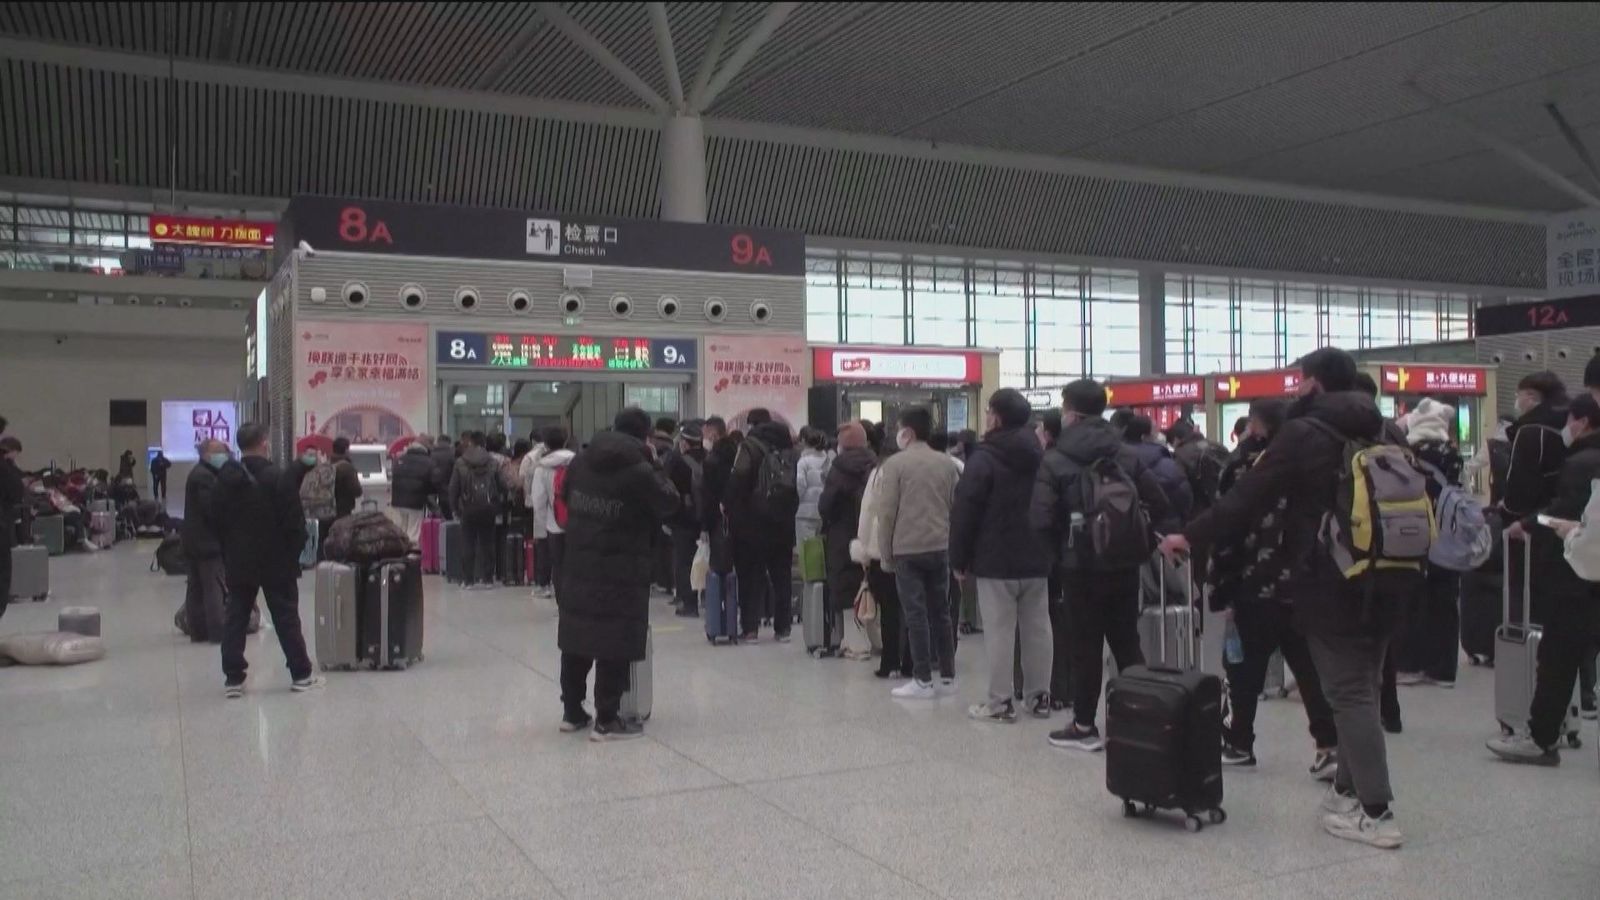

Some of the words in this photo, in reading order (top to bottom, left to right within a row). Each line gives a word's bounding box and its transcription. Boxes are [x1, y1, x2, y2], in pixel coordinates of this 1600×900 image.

[339, 206, 393, 244] 8A
[564, 222, 618, 244] 检票口
[564, 244, 595, 257] Check
[731, 233, 773, 267] 9A
[1528, 305, 1568, 327] 12A
[450, 338, 477, 360] 8A
[663, 345, 686, 365] 9A
